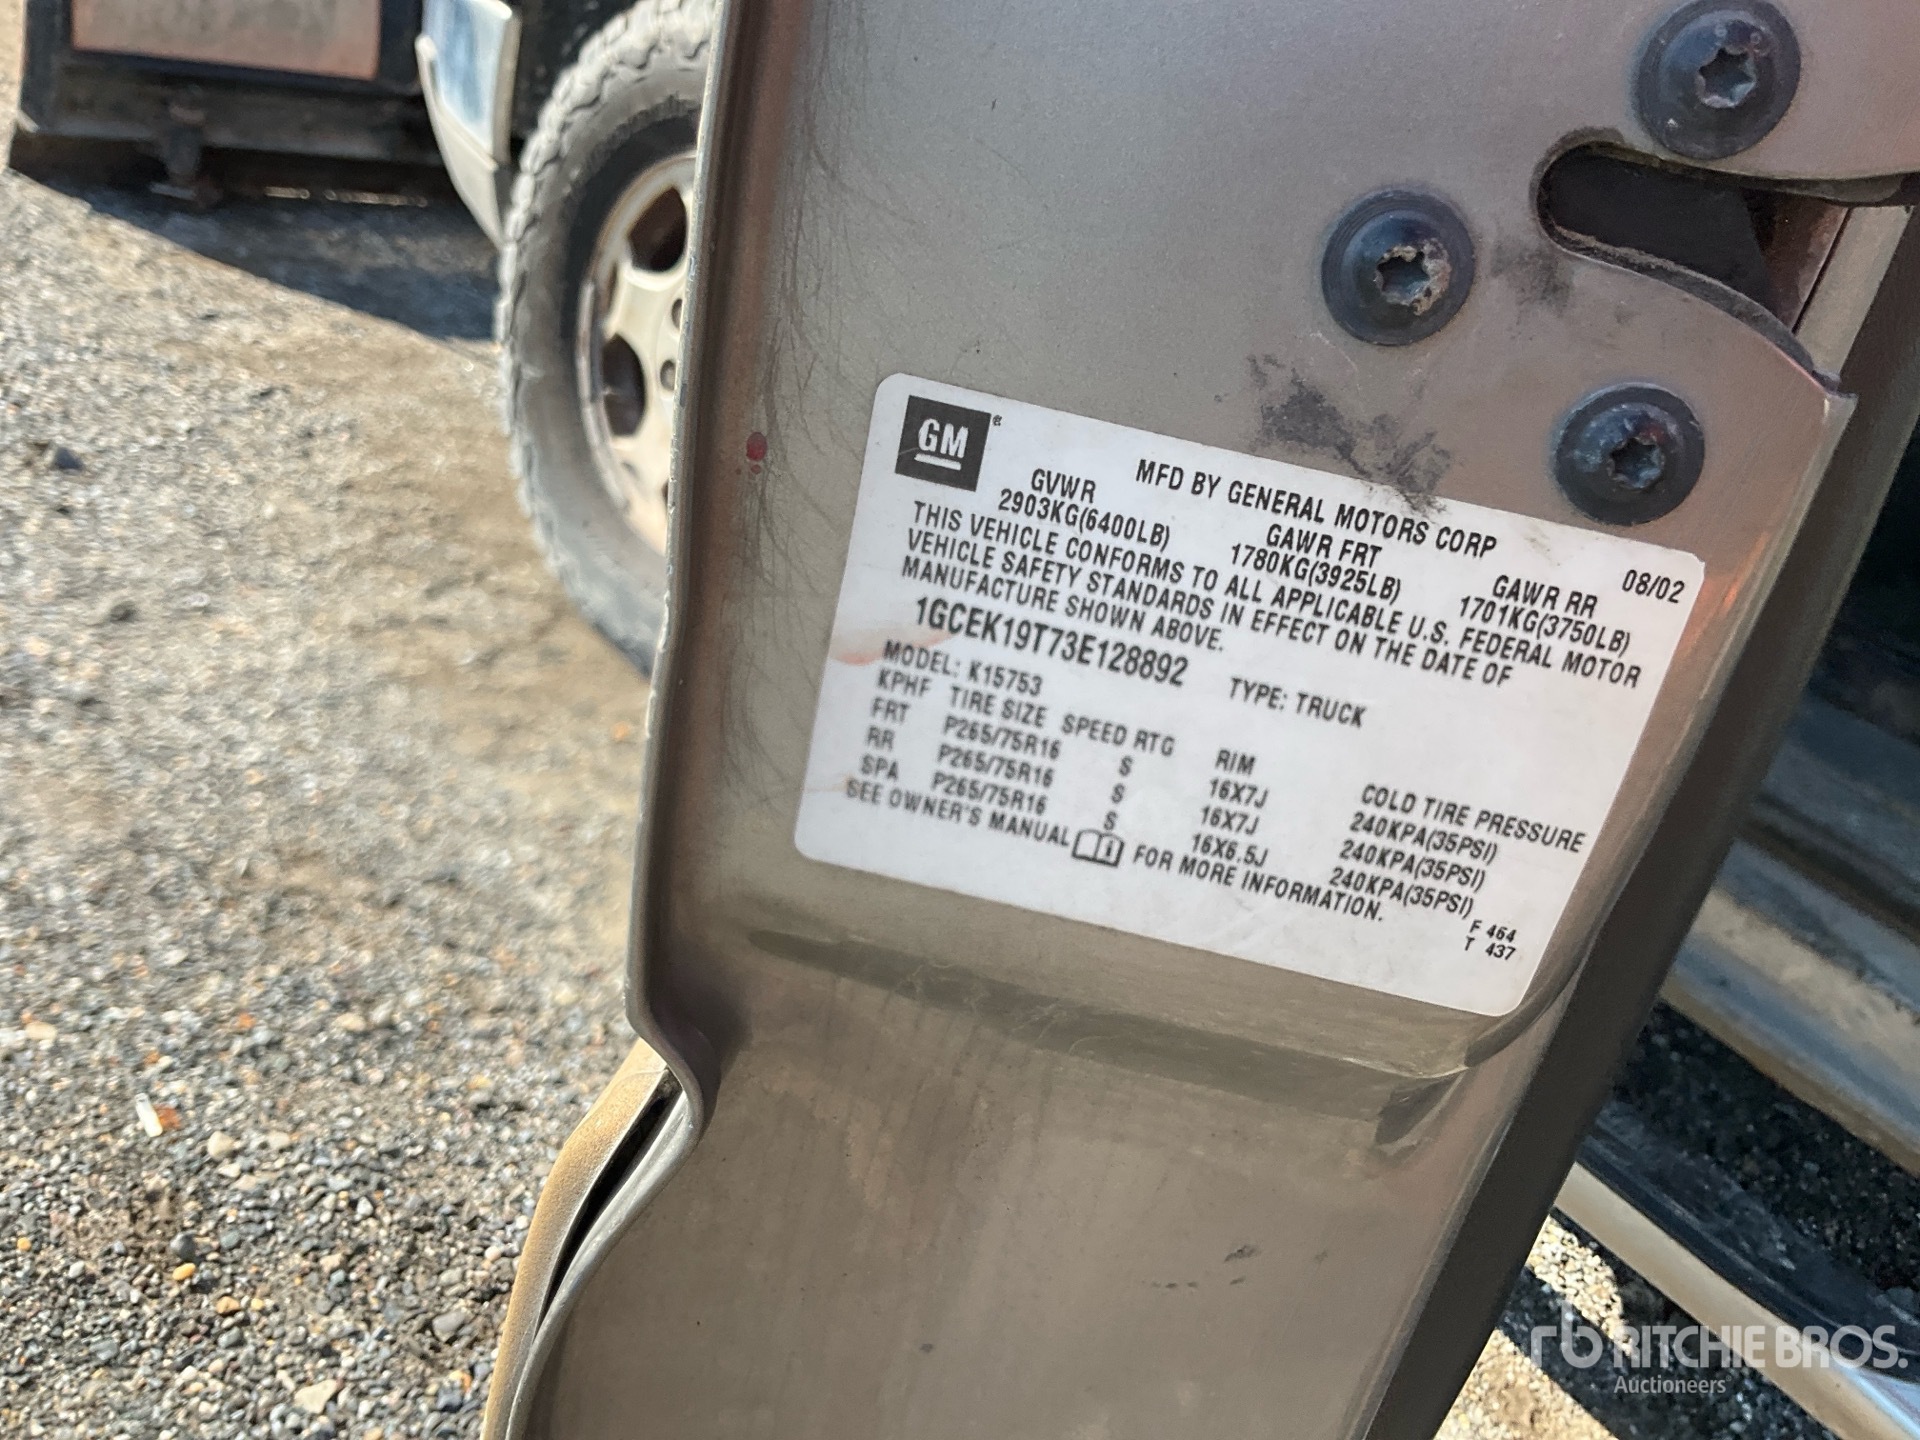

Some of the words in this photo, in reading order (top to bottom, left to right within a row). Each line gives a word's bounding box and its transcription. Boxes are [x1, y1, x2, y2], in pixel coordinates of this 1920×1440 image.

[917, 418, 969, 459] GM
[1031, 468, 1096, 503] GVWR
[1136, 459, 1183, 491] MFD
[1191, 472, 1221, 499] BY
[1228, 480, 1324, 525] GENERAL
[1334, 504, 1427, 544] MOTORS
[1436, 525, 1497, 559] CORP
[998, 488, 1170, 551] 2903KG(6400LB)
[1266, 524, 1332, 559] GAWR
[1338, 540, 1382, 569] FRT
[914, 501, 961, 531] THIS
[971, 513, 1060, 554] VEHICLE
[1065, 537, 1185, 585] CONFORMS
[1192, 566, 1218, 592] TO
[1224, 576, 1262, 603] ALL
[1272, 587, 1402, 636] APPLICABLE
[1408, 618, 1449, 646] U.S.
[1459, 628, 1552, 668] FEDERAL
[1562, 652, 1642, 689] MOTOR
[1231, 544, 1402, 604] 1780KG(3925LB)
[1493, 575, 1560, 610] GAWR
[1566, 592, 1598, 619] RR
[1622, 569, 1685, 604] 08/02
[901, 556, 1059, 613] MANUFACTURE
[1064, 598, 1144, 633] SHOWN
[1151, 617, 1225, 653] ABOVE.
[908, 528, 996, 569] VEHICLE
[1001, 551, 1082, 589] SAFETY
[1086, 571, 1211, 620] STANDARDS
[1220, 604, 1242, 627] IN
[1251, 607, 1329, 643] EFFECT
[1334, 629, 1367, 655] ON
[1373, 639, 1412, 667] THE
[1421, 652, 1475, 681] DATE
[1482, 665, 1514, 689] OF
[1459, 596, 1630, 657] 1701KG(3750LB)
[882, 639, 960, 677] MODEL:
[967, 661, 1043, 697] K15753
[914, 597, 1189, 685] 1GCEK19T73E128892
[950, 686, 995, 716] TIRE
[1001, 699, 1047, 728] SIZE
[1061, 714, 1127, 747] SPEED
[1133, 728, 1176, 756] RTG
[1230, 678, 1288, 711] TYPE:
[1295, 691, 1367, 729] TRUCK
[866, 725, 895, 751] RR
[936, 743, 1055, 787] P265/75R16
[1111, 783, 1127, 803] S
[871, 697, 910, 724] FRT
[943, 715, 1062, 760] P265/75R16
[1118, 756, 1135, 776] S
[1215, 749, 1257, 776] RIM
[846, 780, 883, 805] SEE
[889, 791, 982, 827] OWNER'S
[988, 813, 1071, 848] MANUAL
[860, 753, 899, 781] SPA
[930, 771, 1048, 815] P265/75R16
[1103, 811, 1118, 832] S
[1200, 805, 1260, 836] 16X7J
[1208, 778, 1270, 809] 16X7J
[1361, 784, 1417, 814] COLD
[1422, 797, 1471, 827] TIRE
[1474, 809, 1588, 853] PRESSURE
[1192, 834, 1270, 868] 16X6.5J
[1339, 839, 1487, 894] 240KPA(35PSI)
[1349, 812, 1499, 865] 240KPA(35PSI)
[1132, 844, 1173, 871] FOR
[1179, 858, 1235, 887] MORE
[1241, 871, 1384, 923] INFORMATION.
[1328, 867, 1475, 920] 240KPA(35PSI)
[1464, 936, 1476, 951] T
[1485, 943, 1517, 961] 437
[1470, 919, 1483, 934] F
[1486, 924, 1517, 943] 464
